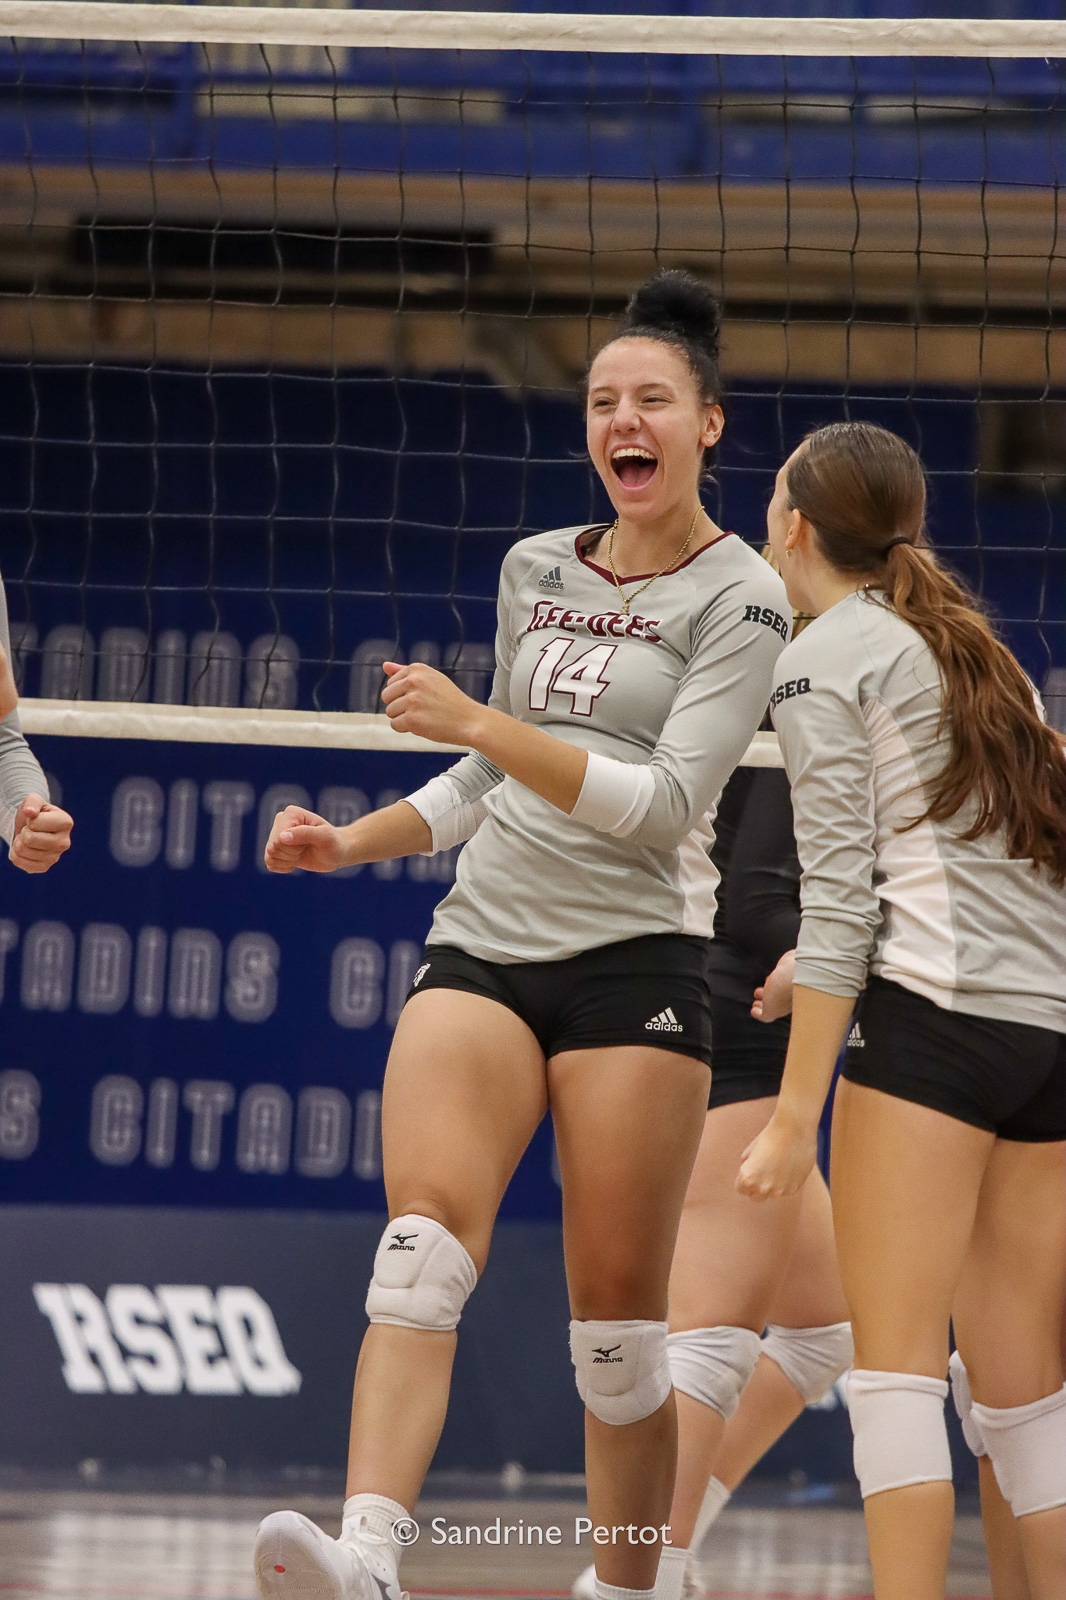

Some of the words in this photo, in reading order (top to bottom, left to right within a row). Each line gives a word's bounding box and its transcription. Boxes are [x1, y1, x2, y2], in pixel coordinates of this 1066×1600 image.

[538, 578, 565, 590] adidas
[741, 605, 789, 644] RSEQ
[528, 636, 619, 718] 14
[644, 1021, 684, 1033] adidas
[33, 1283, 302, 1396] RSEQ
